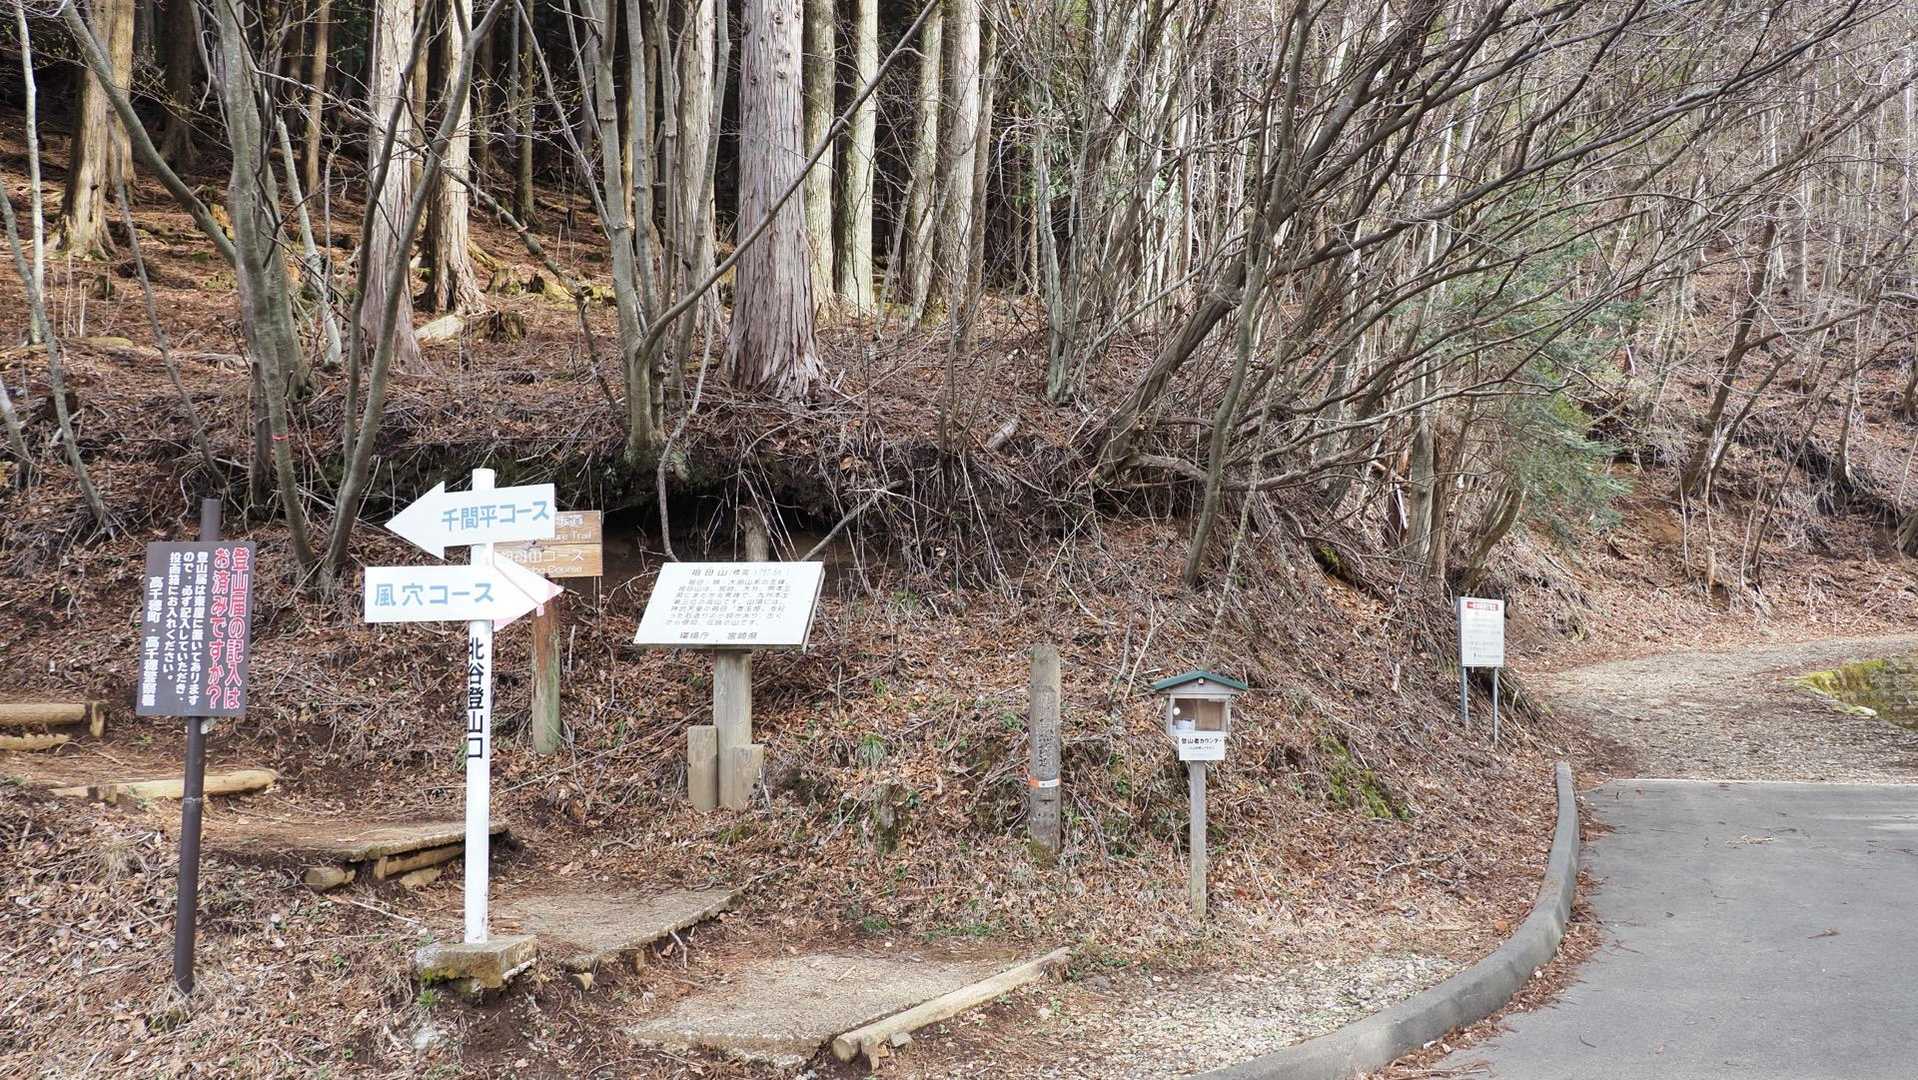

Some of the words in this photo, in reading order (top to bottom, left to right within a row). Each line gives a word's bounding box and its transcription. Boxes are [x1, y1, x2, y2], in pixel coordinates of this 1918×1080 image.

[441, 499, 550, 532] 千間平コース
[223, 546, 250, 710] 登山届の記入は
[374, 582, 495, 607] 風穴コース
[467, 636, 485, 760] 北谷登山口
